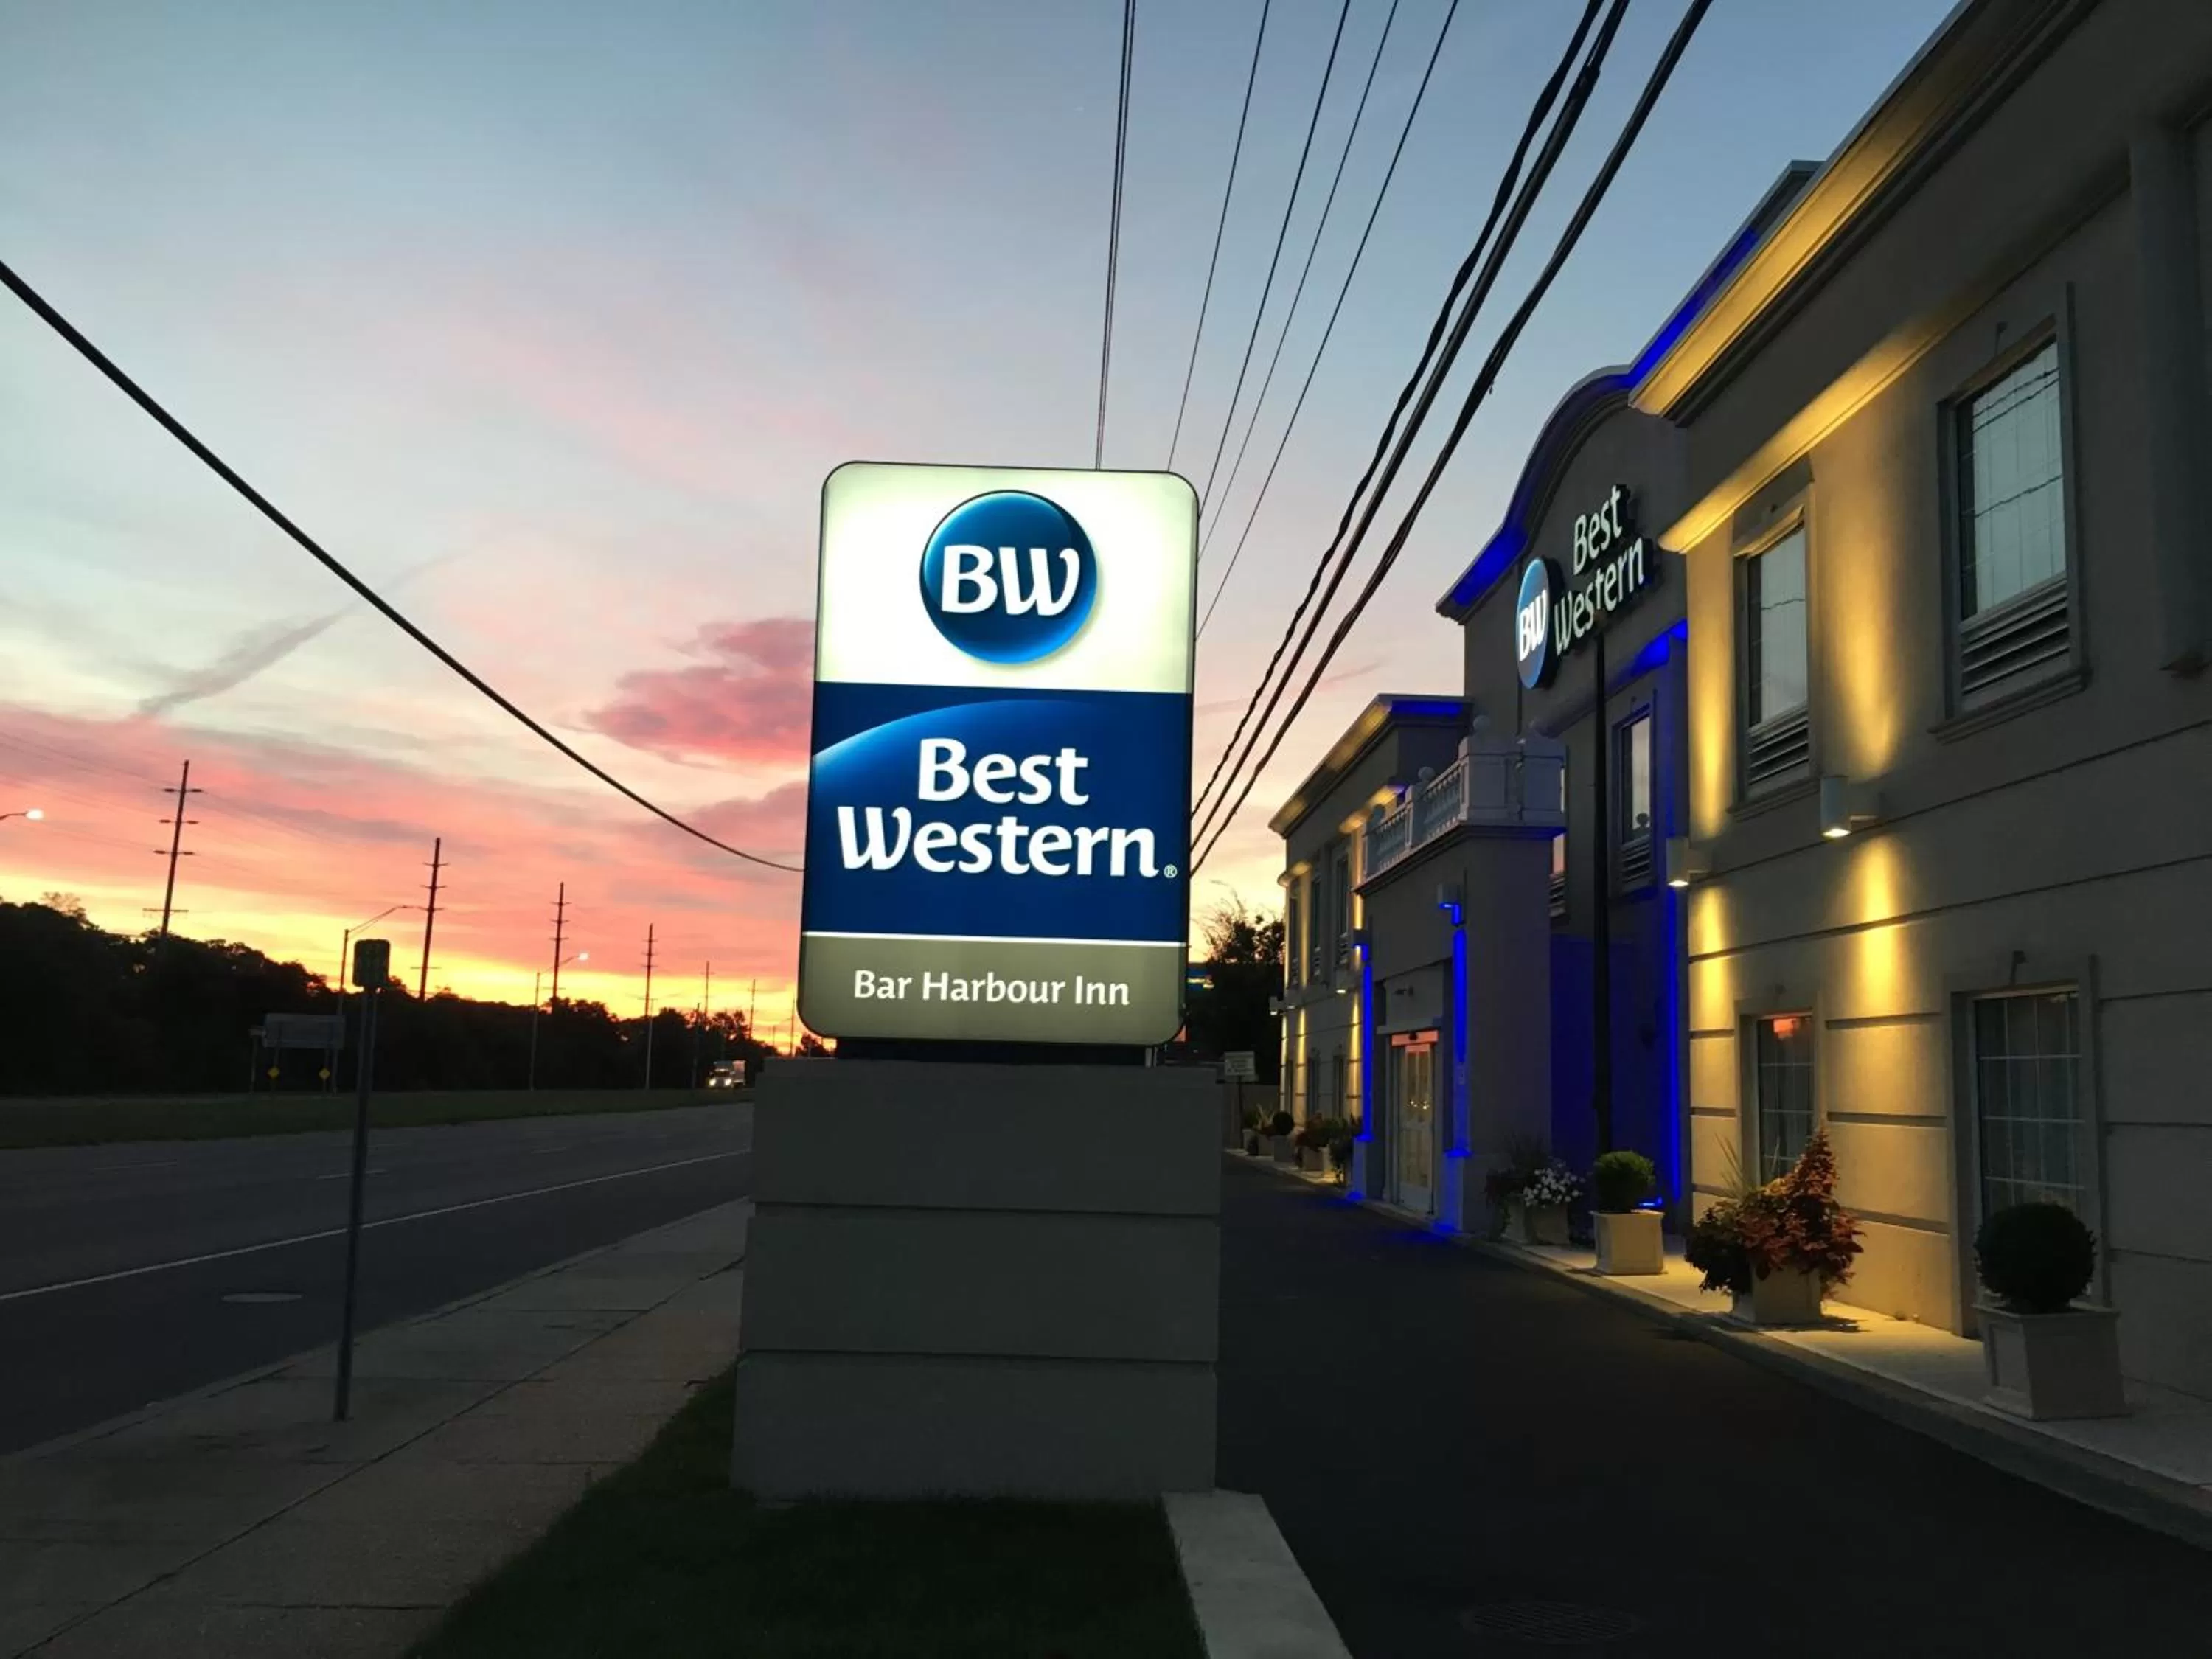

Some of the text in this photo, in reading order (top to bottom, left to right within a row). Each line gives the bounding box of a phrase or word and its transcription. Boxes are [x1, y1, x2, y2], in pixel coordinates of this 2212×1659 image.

[1573, 485, 1622, 575] Best
[941, 545, 1081, 616] BW
[1554, 537, 1644, 656] Western
[1519, 589, 1547, 661] BW
[918, 738, 1090, 806] Best
[854, 969, 1130, 1006] Bar Harbour Inn
